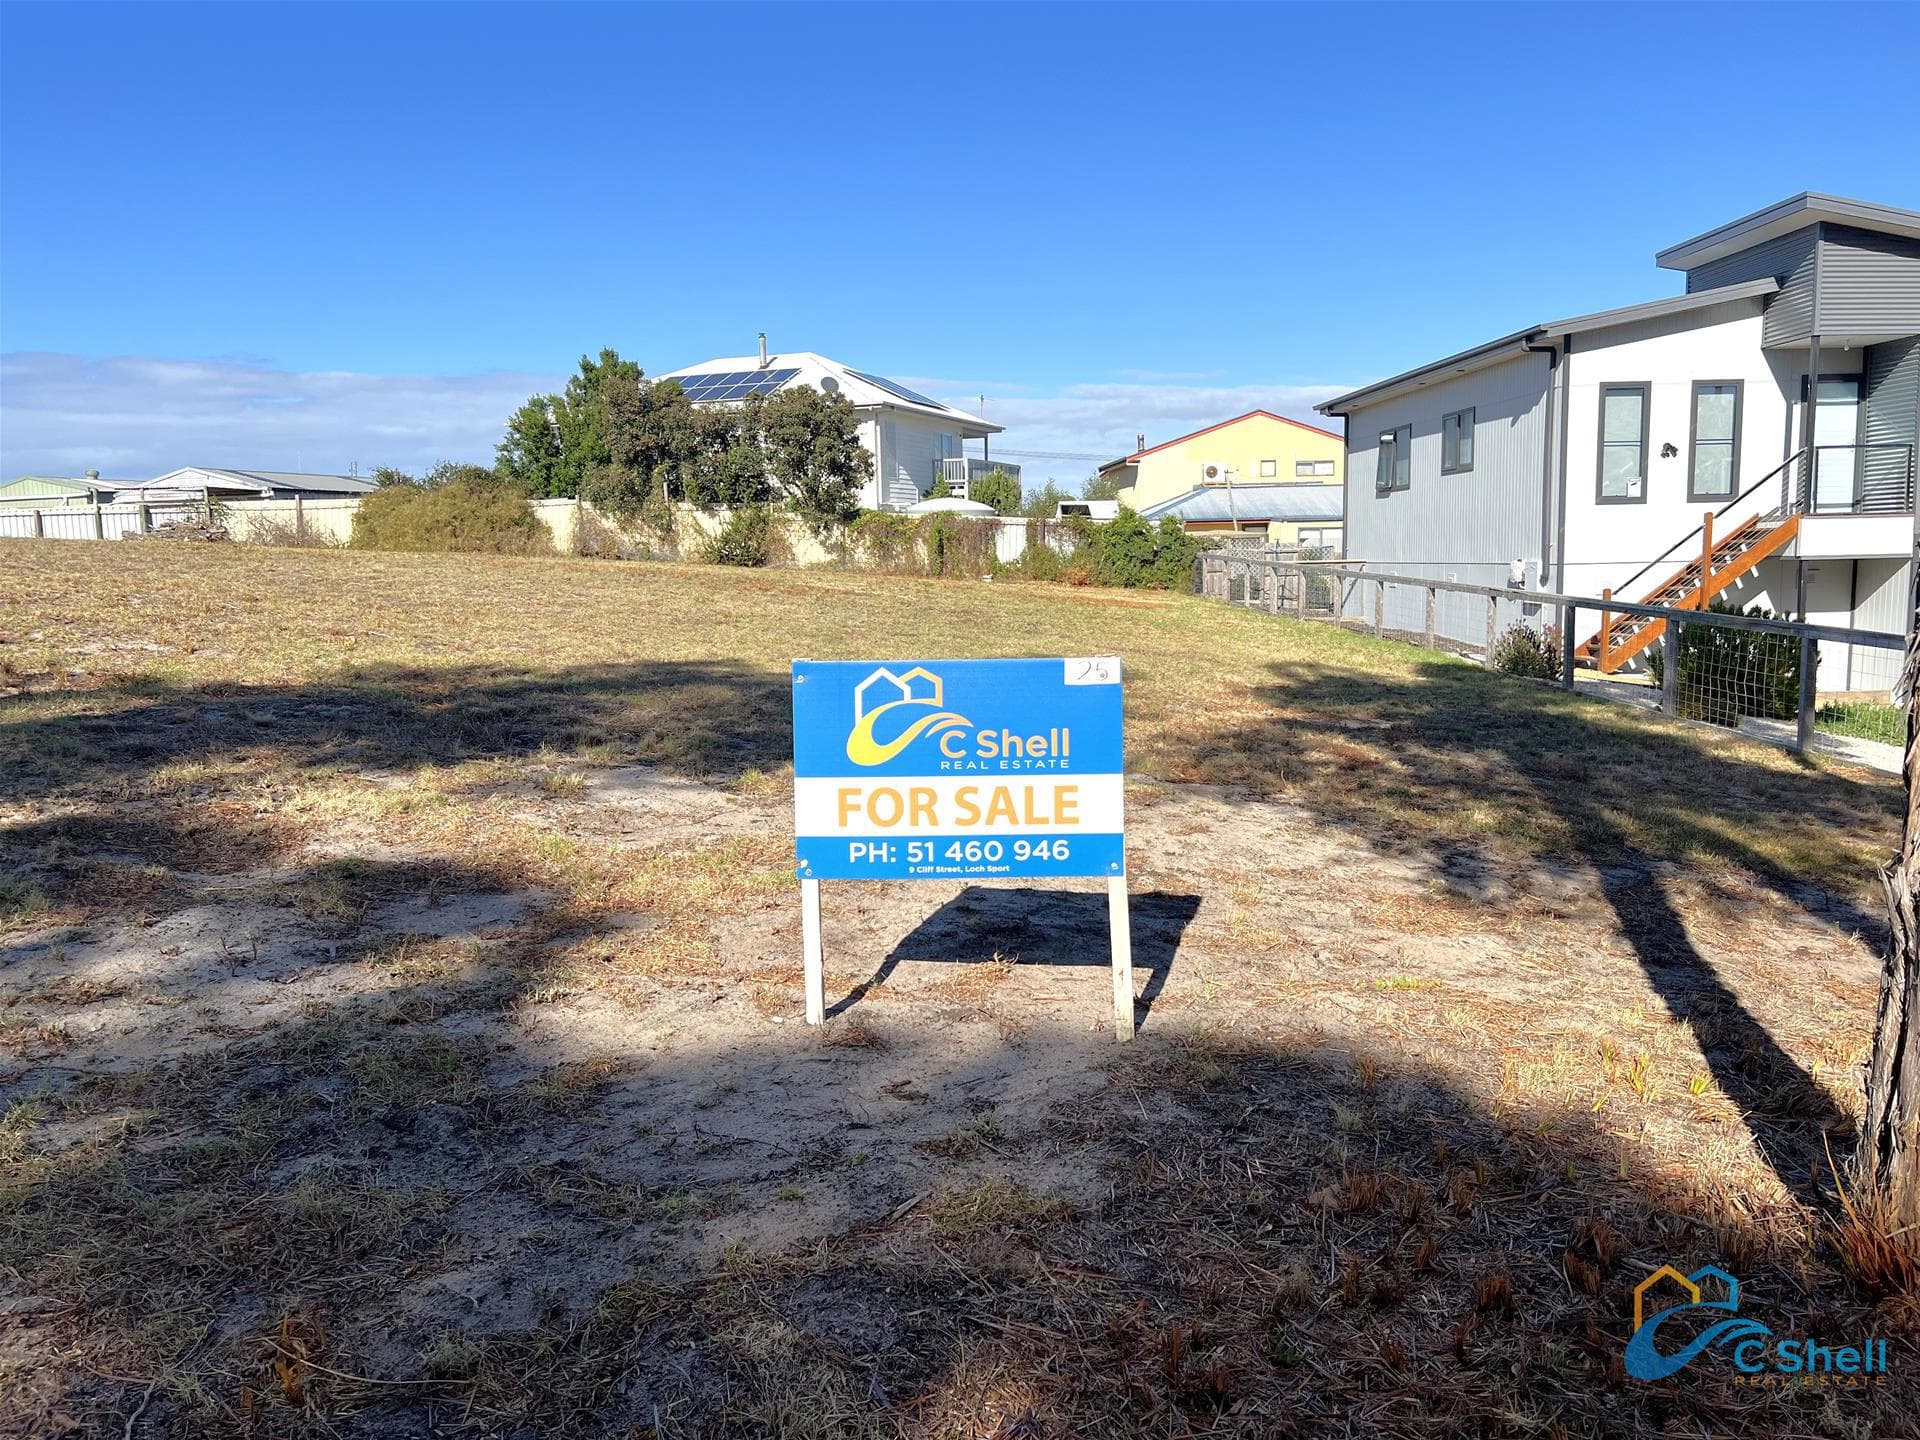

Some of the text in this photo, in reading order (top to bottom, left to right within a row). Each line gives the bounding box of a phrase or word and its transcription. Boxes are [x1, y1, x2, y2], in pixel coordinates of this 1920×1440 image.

[1077, 660, 1109, 681] 25
[939, 728, 1070, 758] C Shell
[940, 759, 1069, 770] REAL ESTATE
[837, 785, 1080, 827] FOR SALE
[849, 839, 1070, 863] PH: 51 460 946
[917, 866, 934, 874] Cliff
[935, 866, 963, 874] Street,
[964, 865, 986, 873] Loch
[987, 865, 1010, 873] Sport
